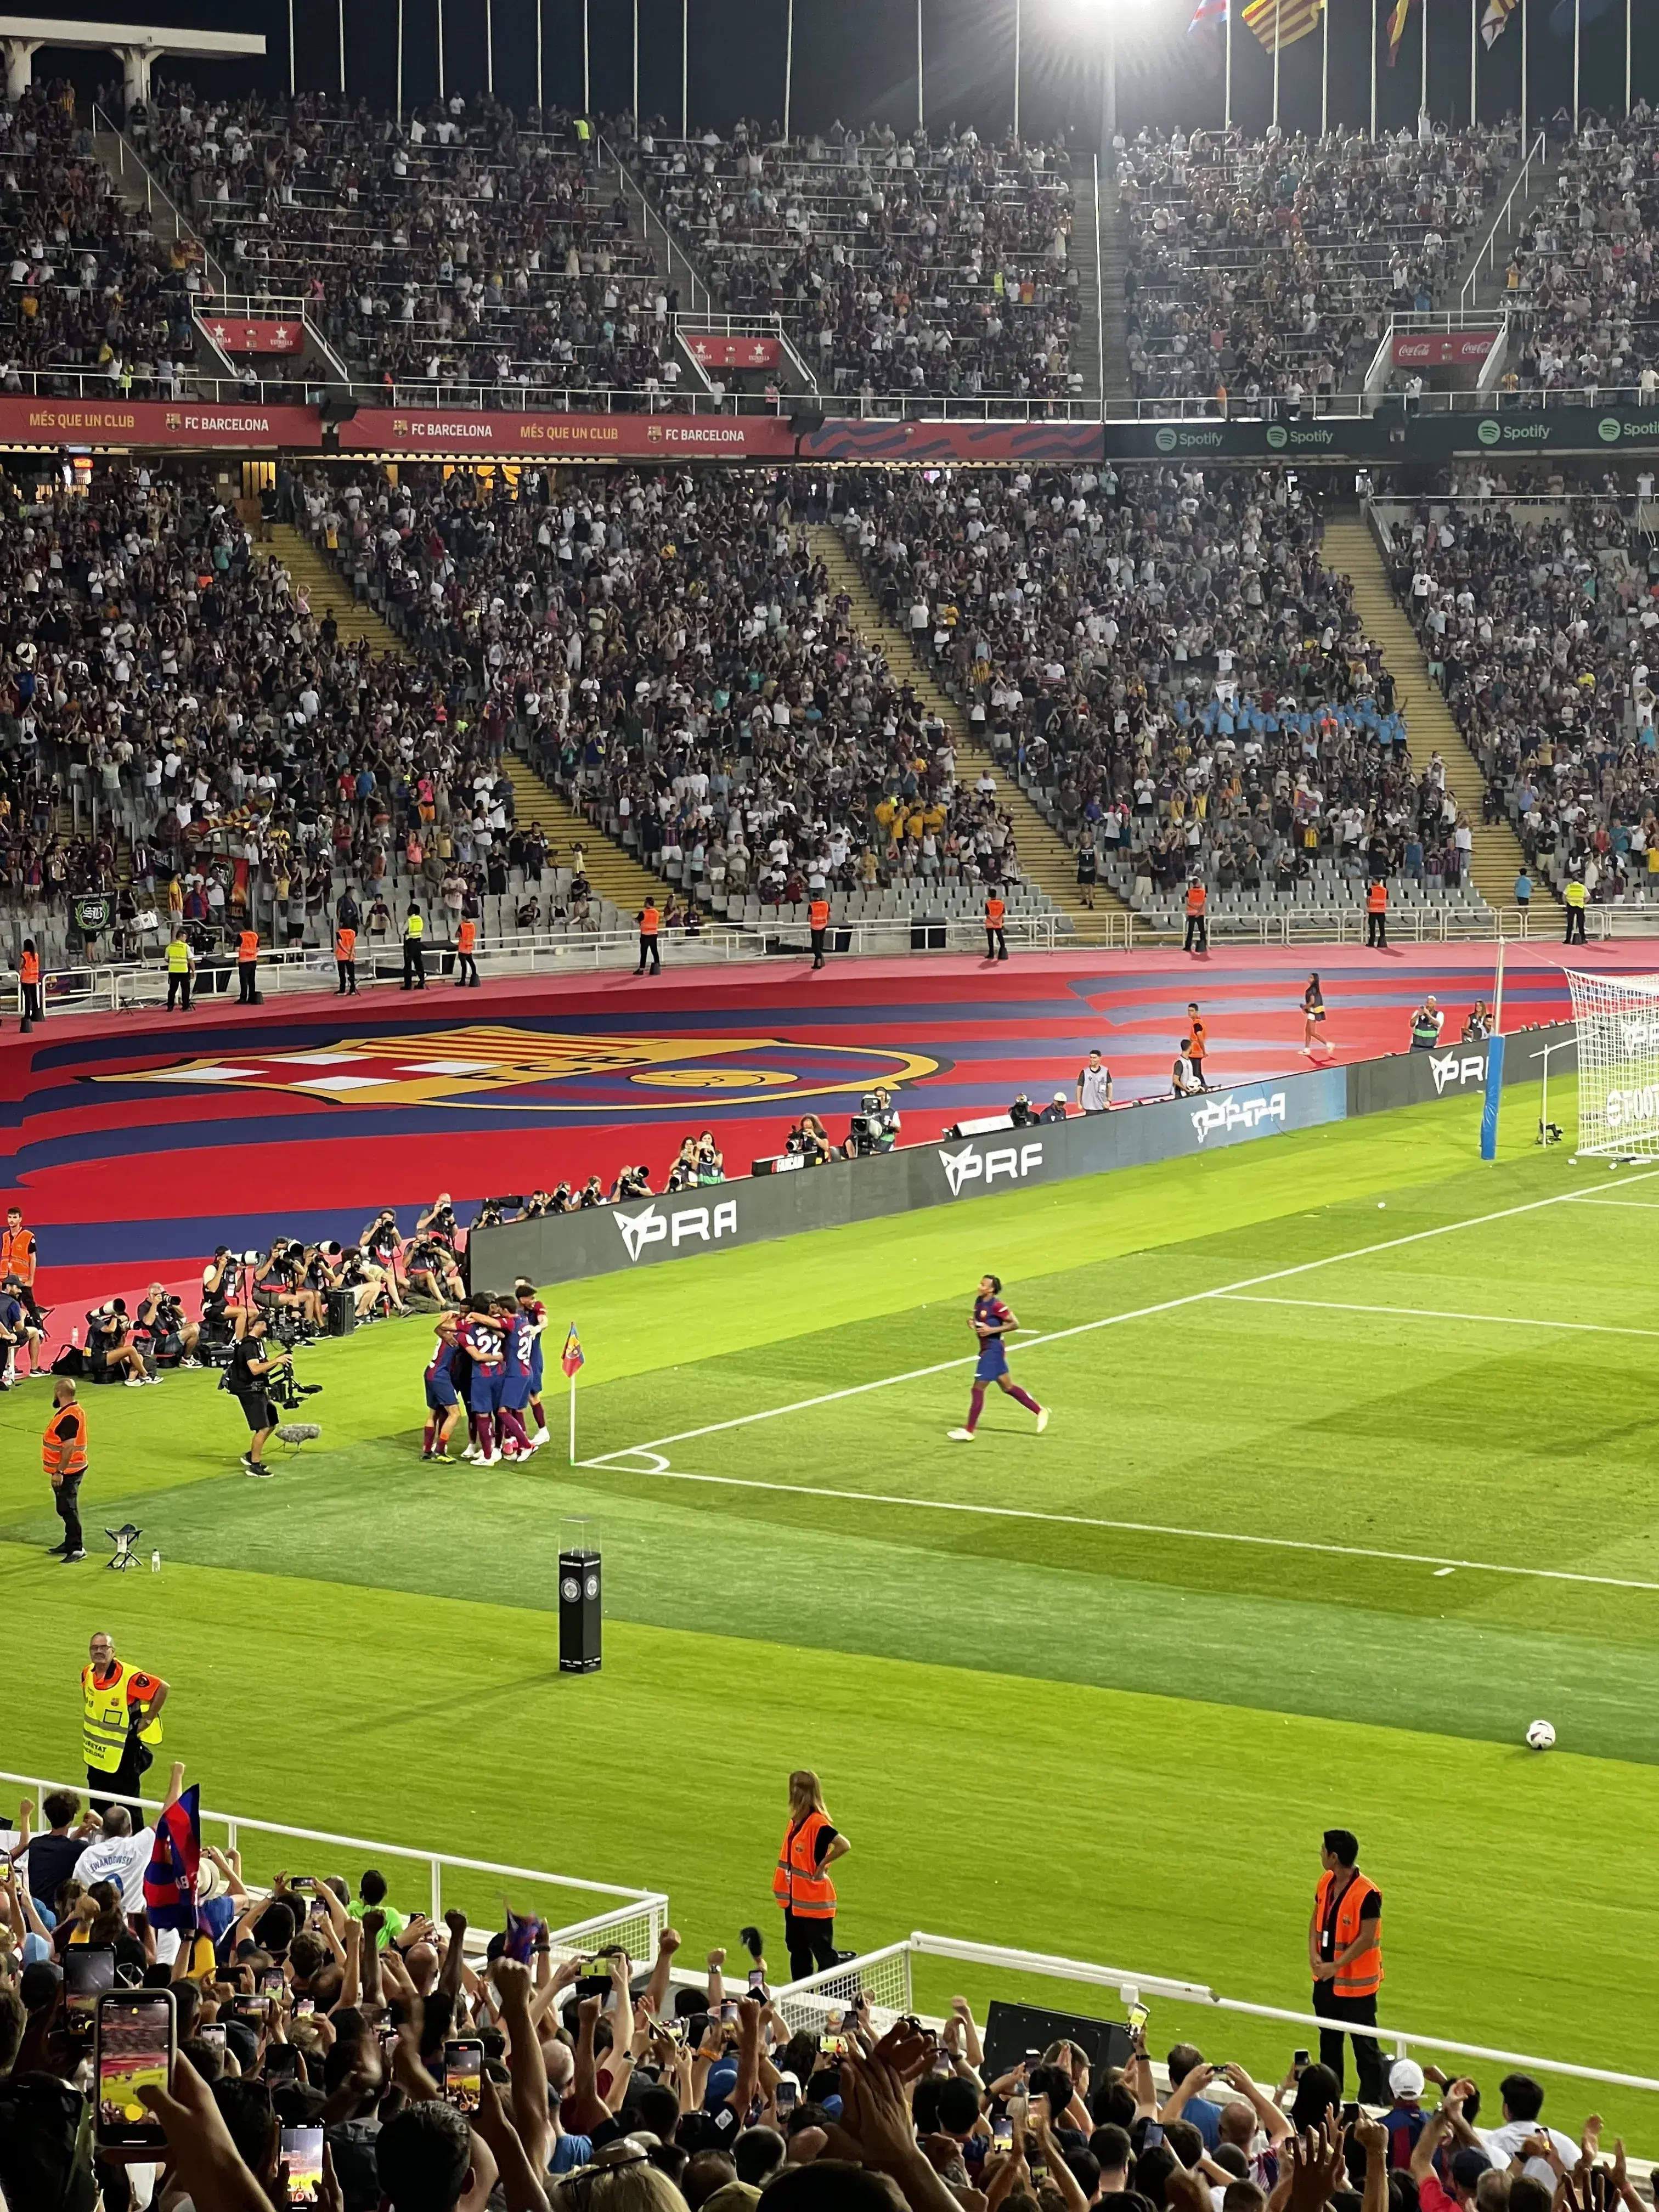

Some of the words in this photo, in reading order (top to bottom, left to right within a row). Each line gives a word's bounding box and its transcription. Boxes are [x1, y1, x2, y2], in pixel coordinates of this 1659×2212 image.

[30, 411, 54, 427] MÉS
[58, 414, 81, 428] QUE
[84, 415, 101, 427] UN
[104, 415, 134, 428] CLUB
[185, 417, 199, 430] FC
[202, 417, 269, 432] BARCELONA
[412, 423, 425, 435] FC
[428, 424, 493, 437] BARCELONA
[521, 423, 544, 438] MÉS
[547, 427, 569, 440] QUE
[572, 427, 588, 438] UN
[590, 427, 618, 439] CLUB
[665, 429, 679, 441] FC
[681, 430, 744, 442] BARCELONA
[1504, 424, 1550, 441] Spotify
[1623, 421, 1659, 437] Spoti
[1180, 432, 1222, 447] Spotify
[1290, 430, 1334, 444] Spotify
